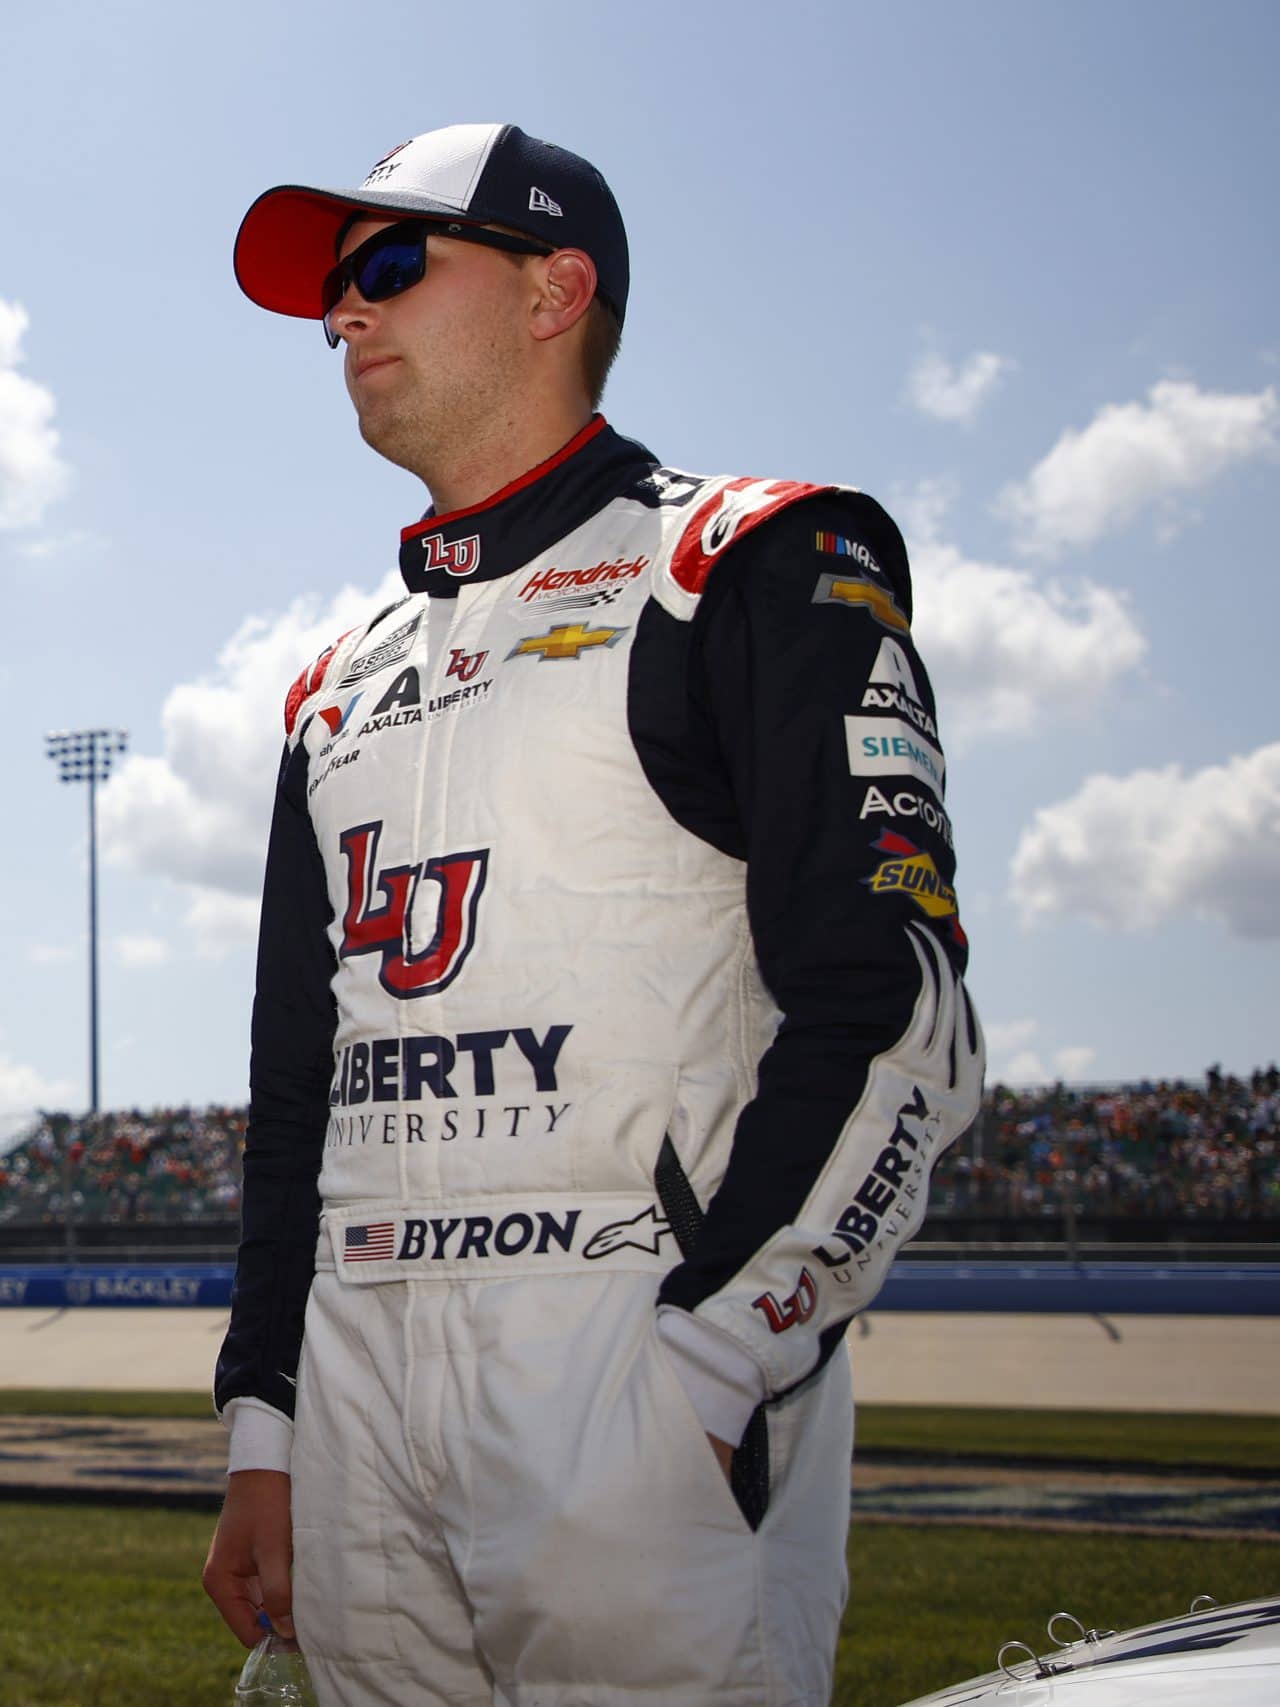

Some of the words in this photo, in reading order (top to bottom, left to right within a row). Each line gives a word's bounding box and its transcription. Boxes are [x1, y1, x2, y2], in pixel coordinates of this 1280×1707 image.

[423, 533, 480, 576] LU
[518, 555, 650, 602] Hendrick
[446, 648, 489, 682] LU
[428, 679, 494, 713] LIBERTY
[357, 708, 423, 738] AXALTA
[339, 819, 491, 1000] LU
[811, 1086, 930, 1268] LIBERTY
[832, 1111, 941, 1285] UNIVERSITY
[396, 1209, 582, 1261] BYRON
[751, 1266, 817, 1335] LU
